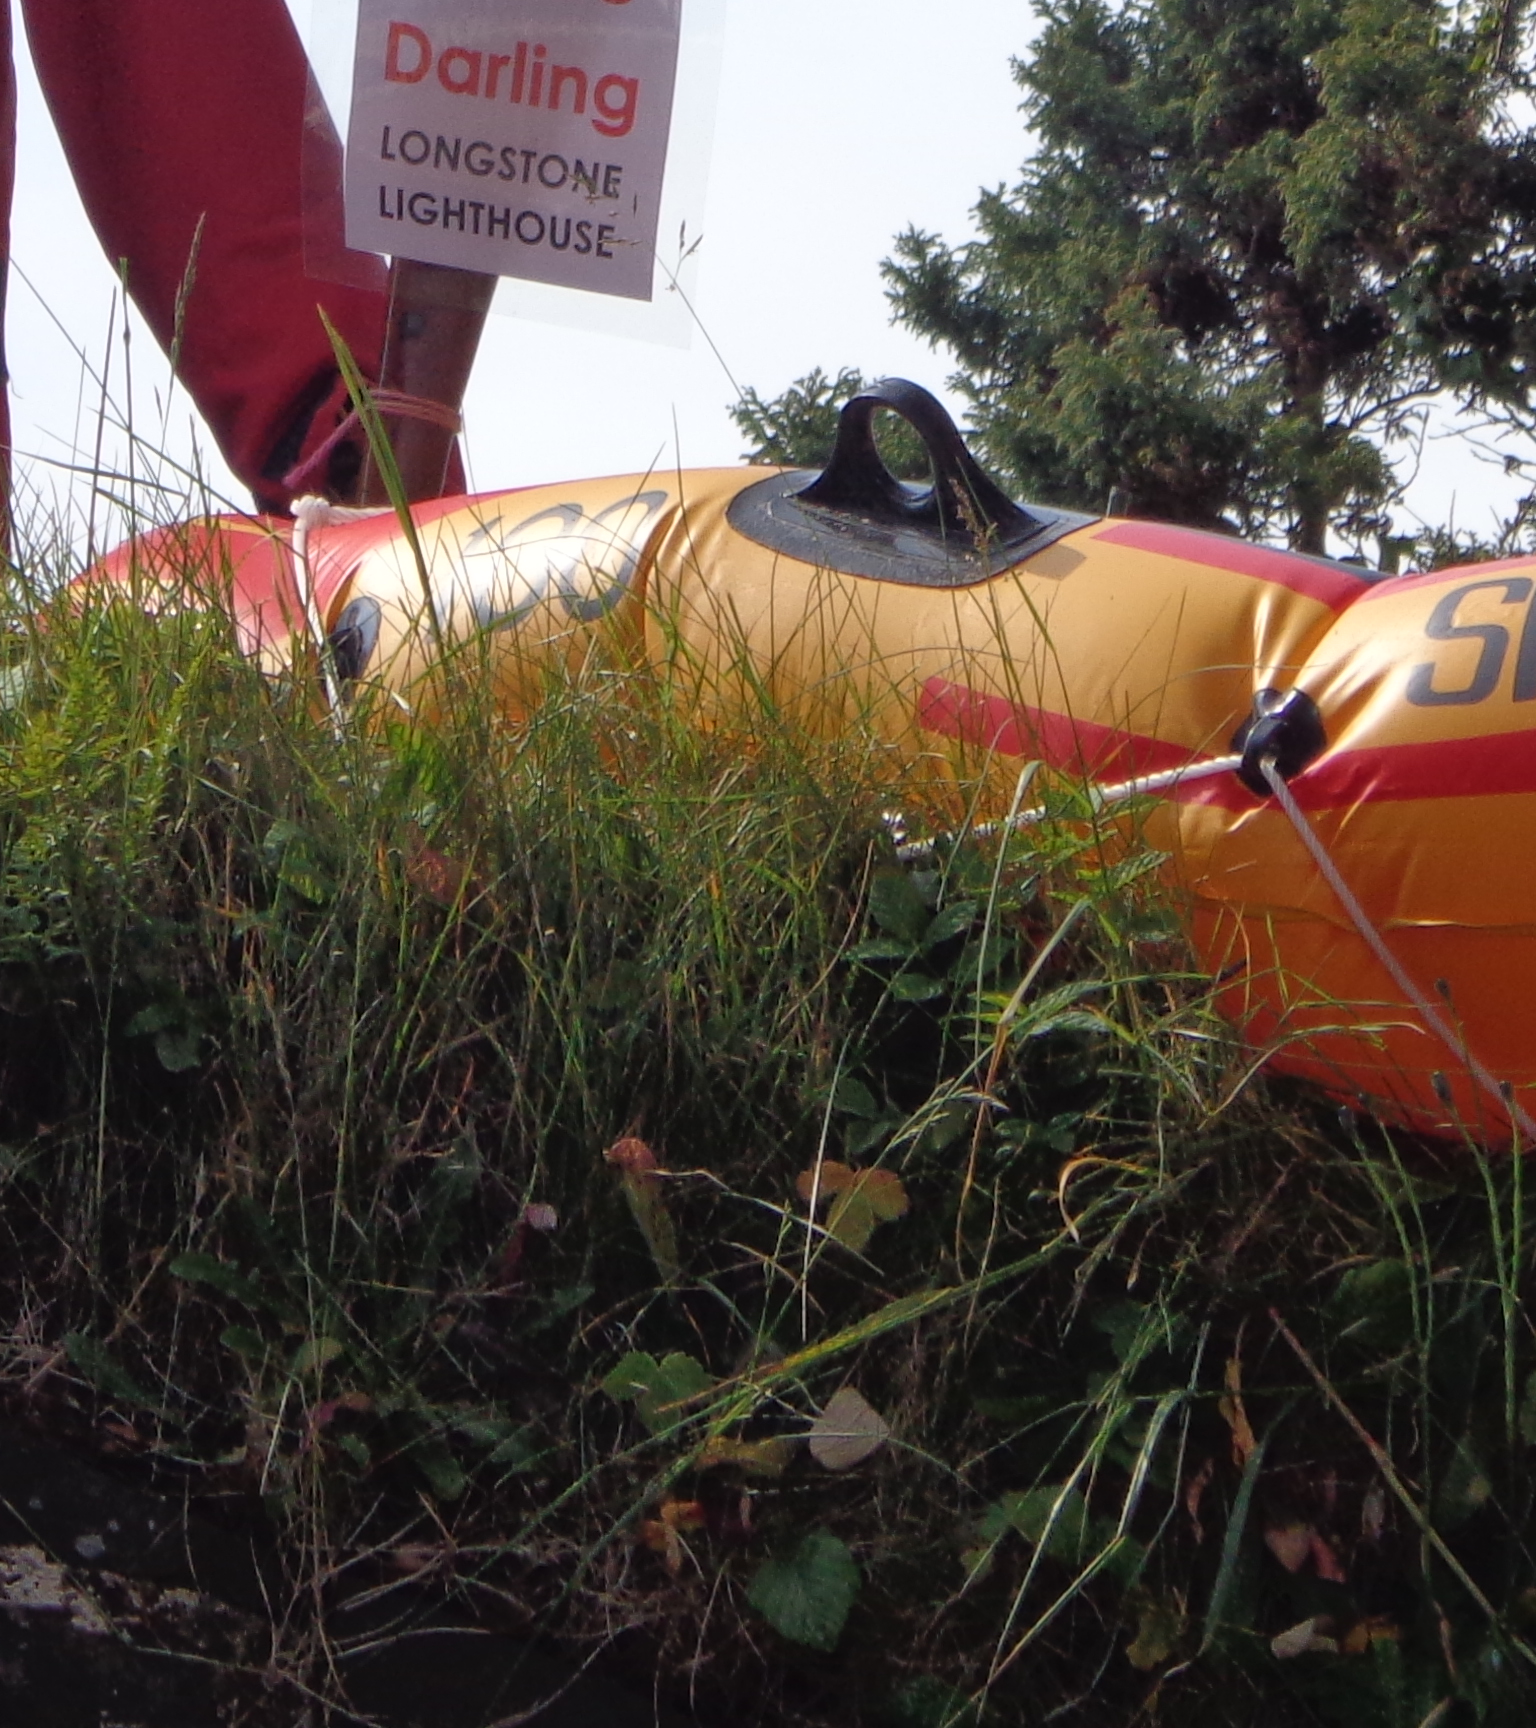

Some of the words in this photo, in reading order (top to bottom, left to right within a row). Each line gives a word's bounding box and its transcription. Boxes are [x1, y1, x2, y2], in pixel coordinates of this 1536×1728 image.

[383, 20, 640, 138] Darling
[380, 124, 623, 200] LONGSTONE
[378, 184, 617, 259] LIGHTHOUSE
